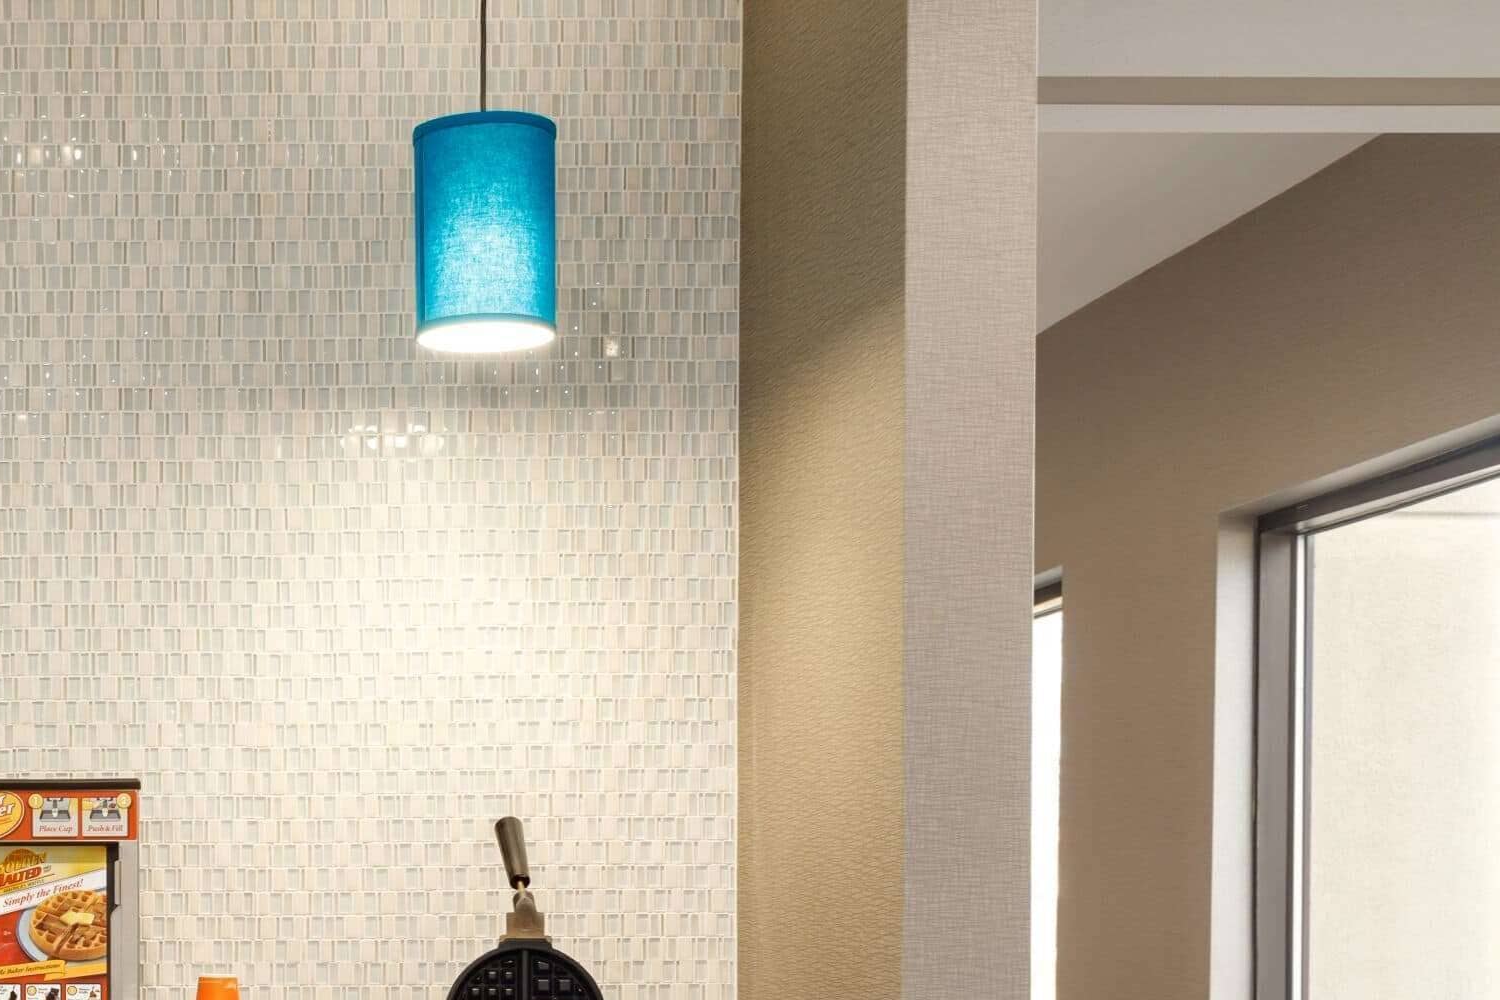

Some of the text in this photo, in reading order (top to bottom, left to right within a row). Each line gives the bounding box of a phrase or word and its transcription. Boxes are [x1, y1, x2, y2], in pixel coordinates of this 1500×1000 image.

[3, 891, 34, 907] Simply
[36, 887, 51, 898] the
[53, 878, 84, 895] Finest!
